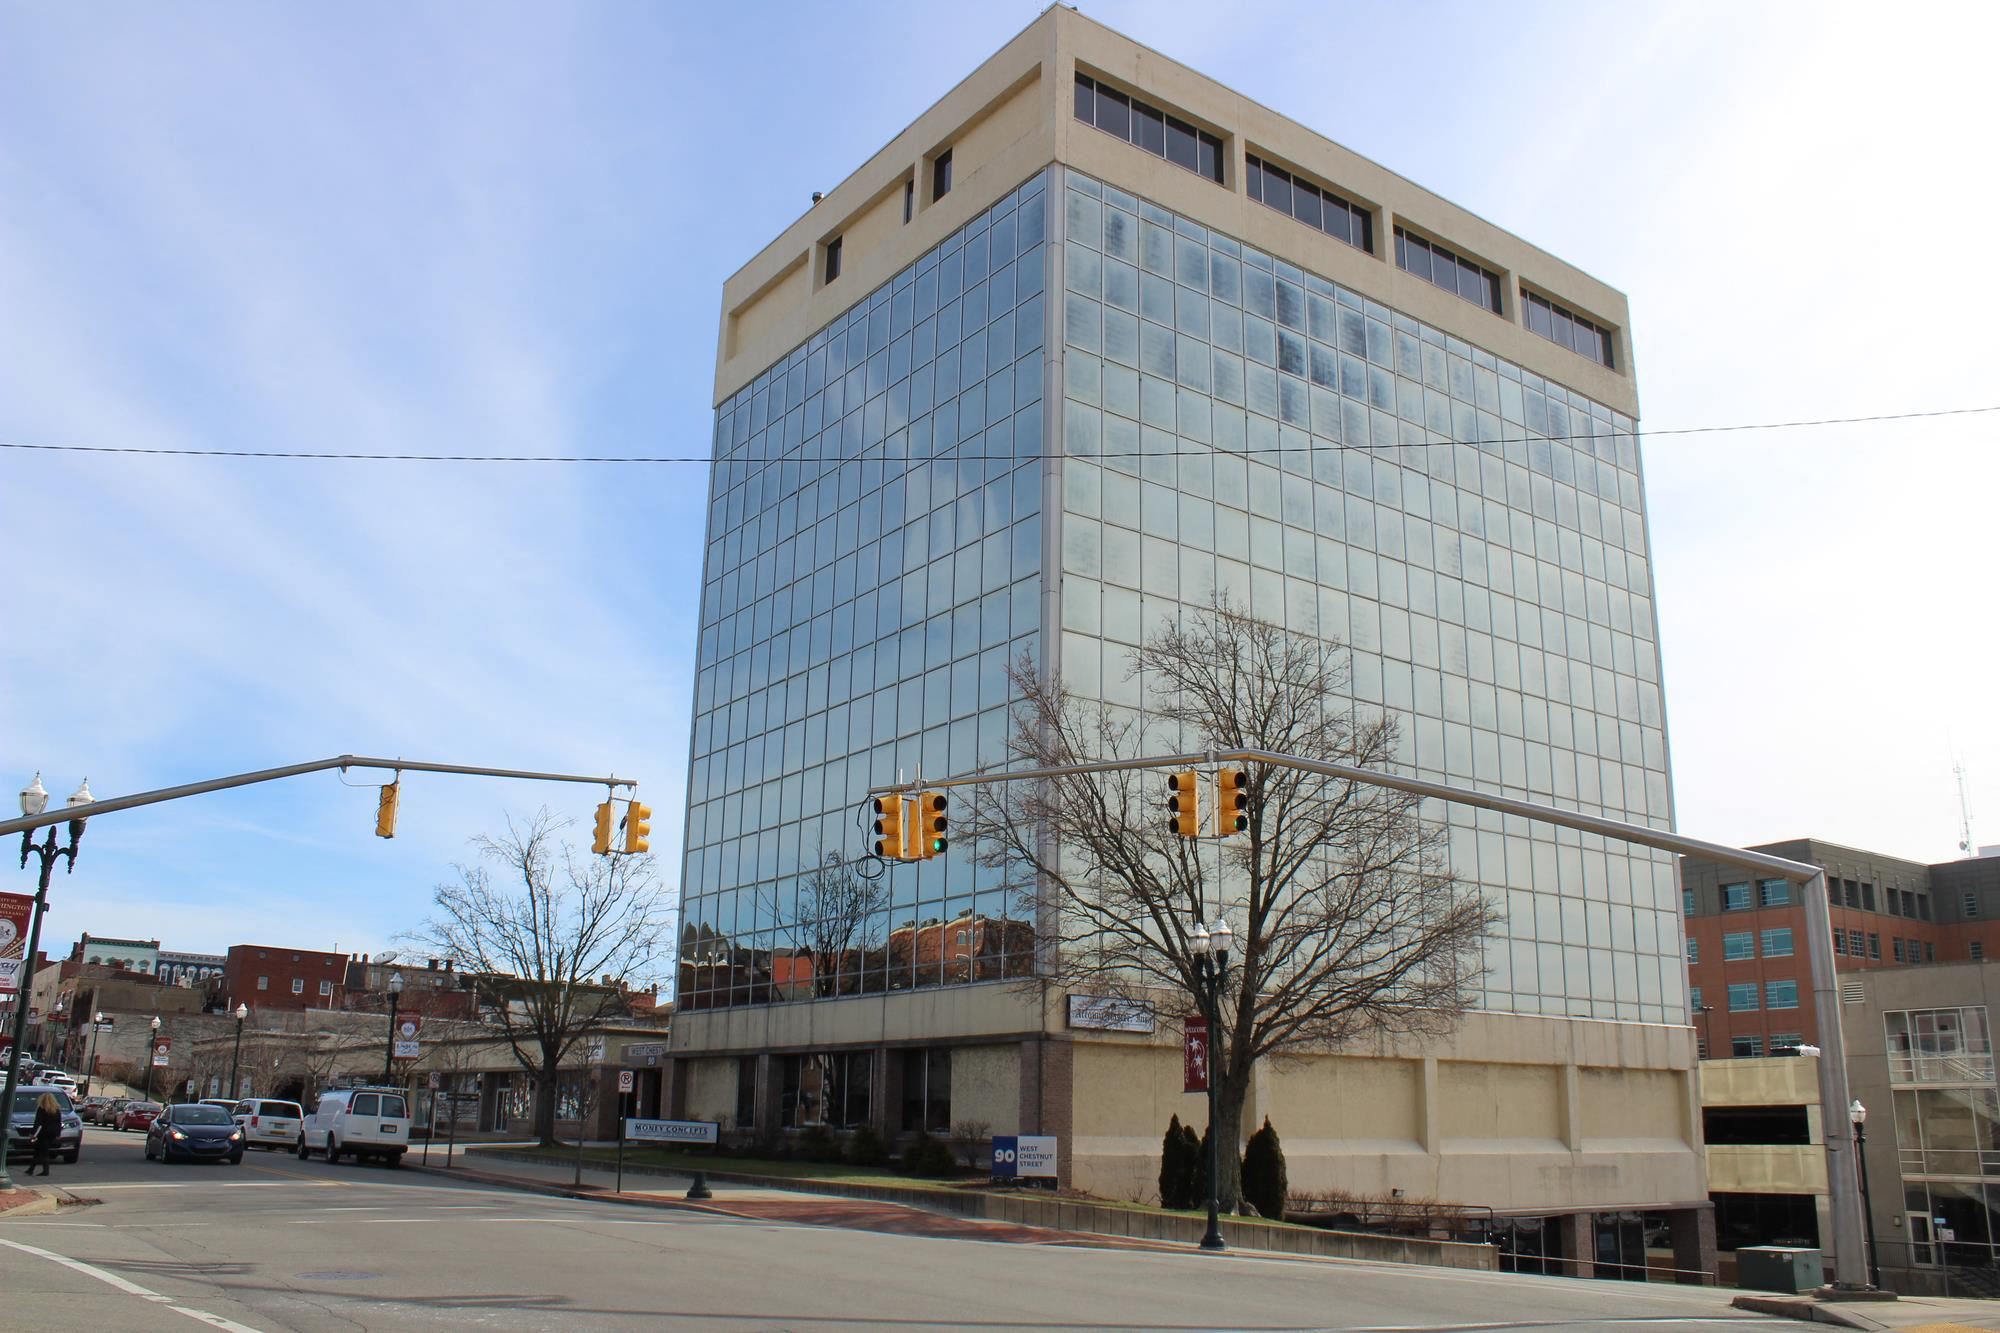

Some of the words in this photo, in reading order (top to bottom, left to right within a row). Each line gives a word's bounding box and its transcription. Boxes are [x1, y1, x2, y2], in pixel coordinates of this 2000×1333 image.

[635, 1123, 663, 1133] MONEY
[666, 1125, 708, 1135] CONCEPTS
[994, 1149, 1016, 1163] 90
